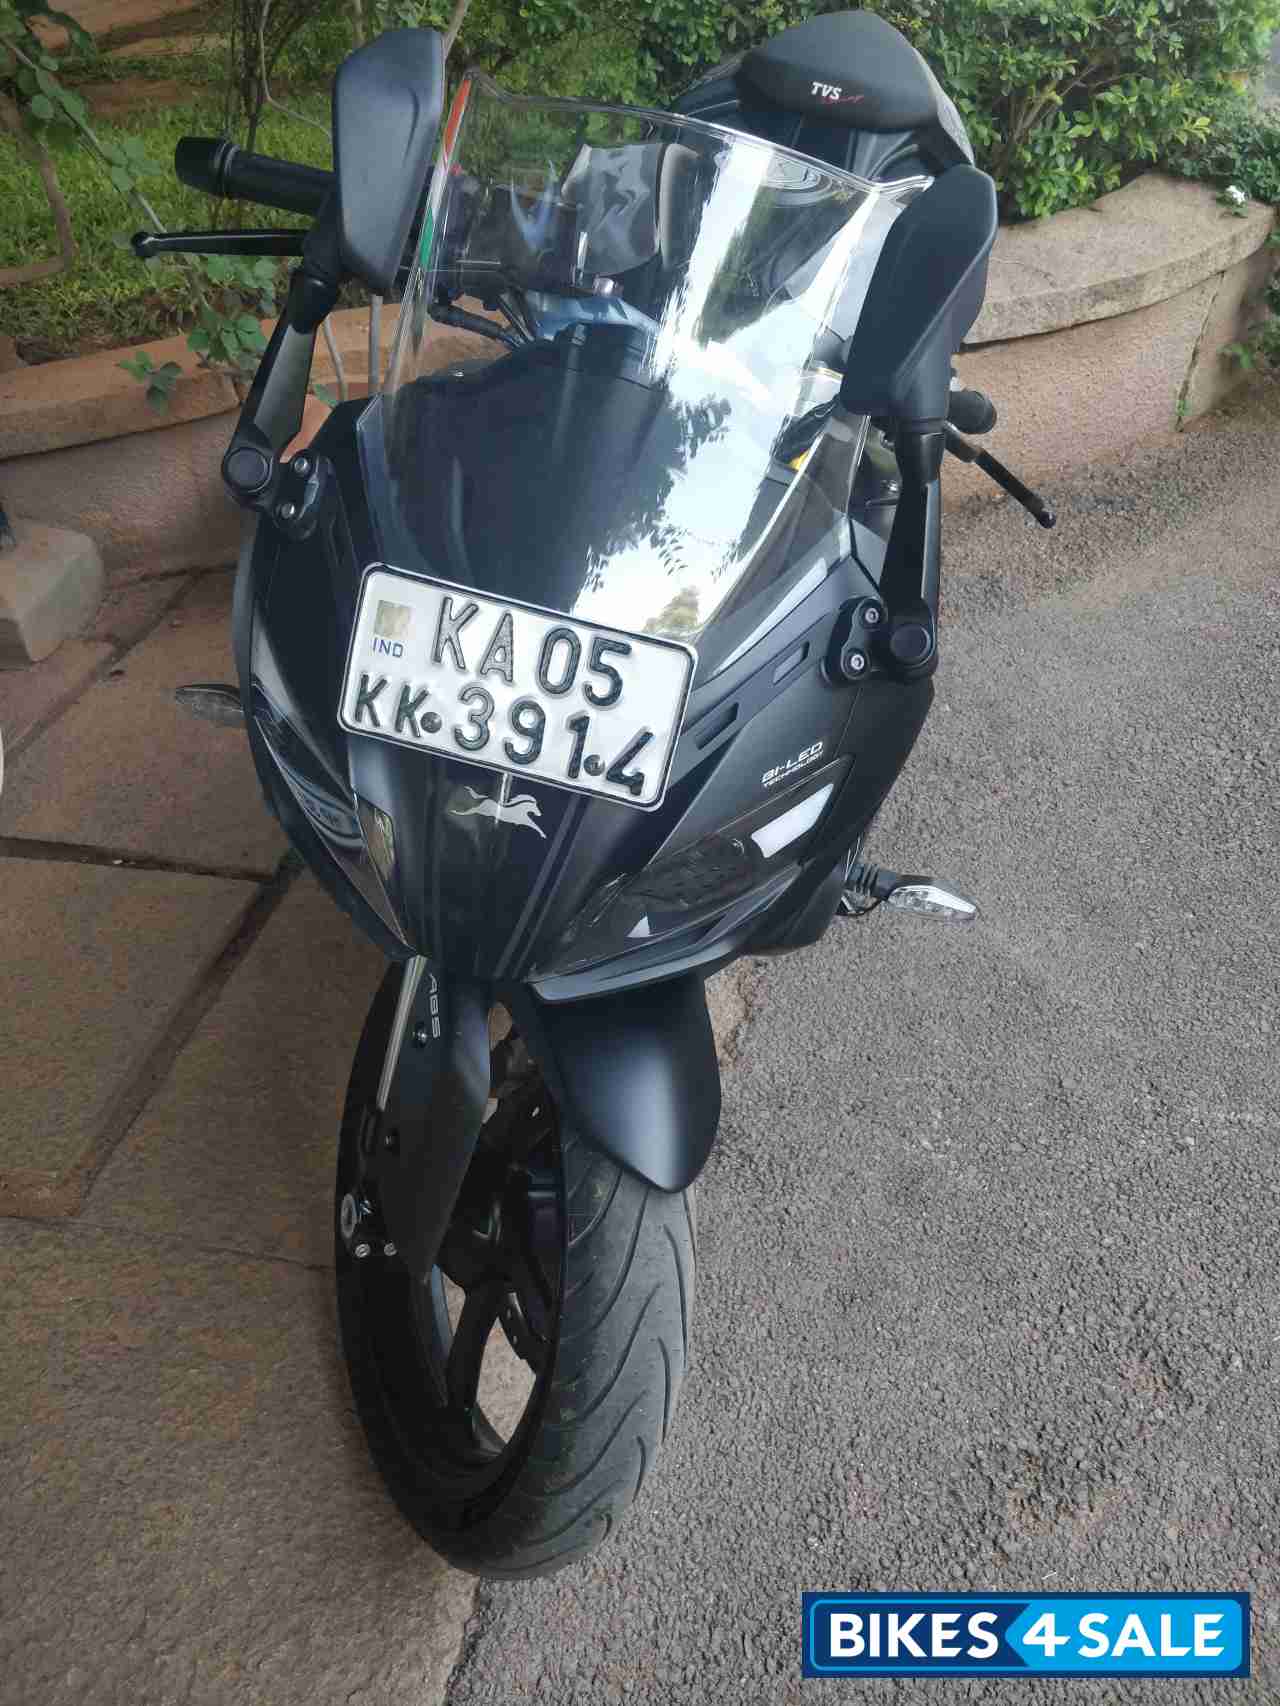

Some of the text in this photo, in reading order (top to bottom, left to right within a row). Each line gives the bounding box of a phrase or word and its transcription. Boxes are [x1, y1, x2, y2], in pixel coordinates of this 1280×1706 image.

[811, 81, 842, 100] TVS
[371, 637, 405, 658] IND
[431, 596, 632, 707] KA 05
[353, 673, 655, 797] KK 3914
[761, 740, 824, 783] BI-LED
[428, 973, 441, 1039] ABS
